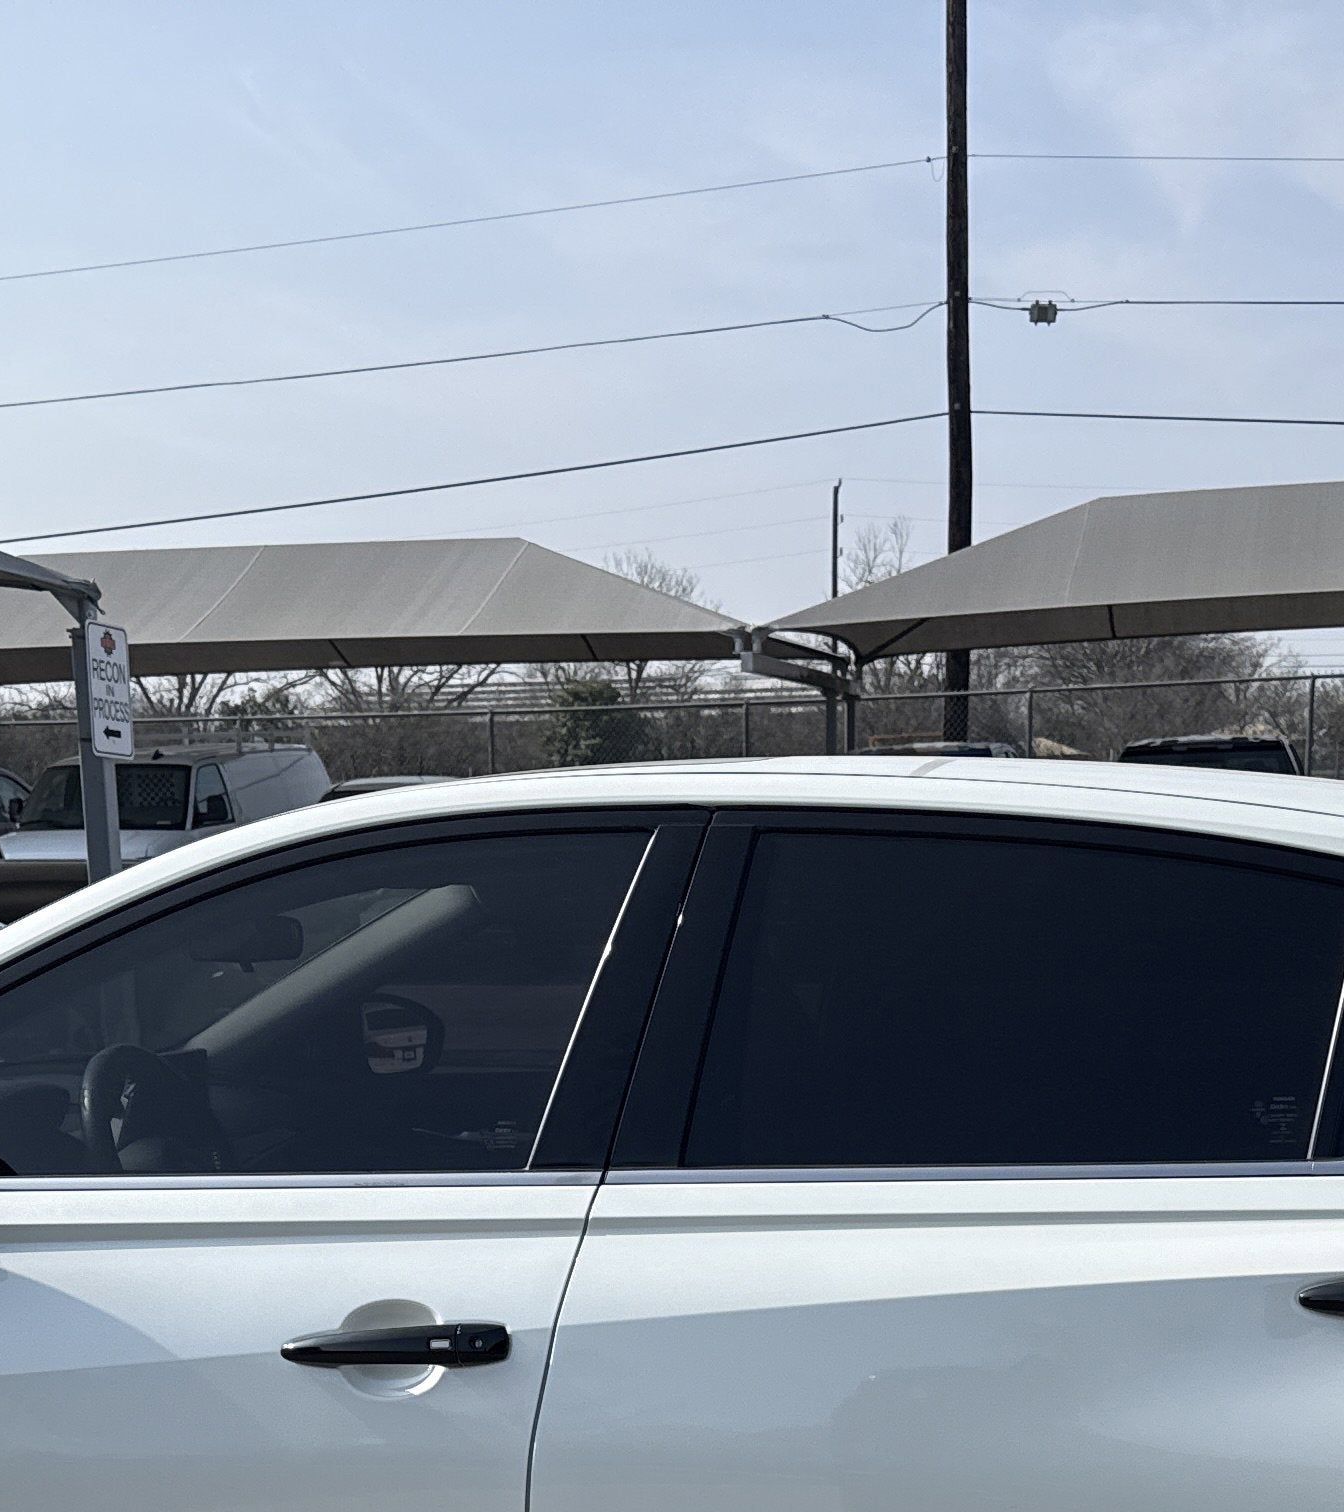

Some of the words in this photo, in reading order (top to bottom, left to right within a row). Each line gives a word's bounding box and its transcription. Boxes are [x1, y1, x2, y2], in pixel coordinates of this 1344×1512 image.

[92, 658, 126, 685] RECON
[106, 684, 114, 697] IN
[94, 697, 130, 723] PROCESS
